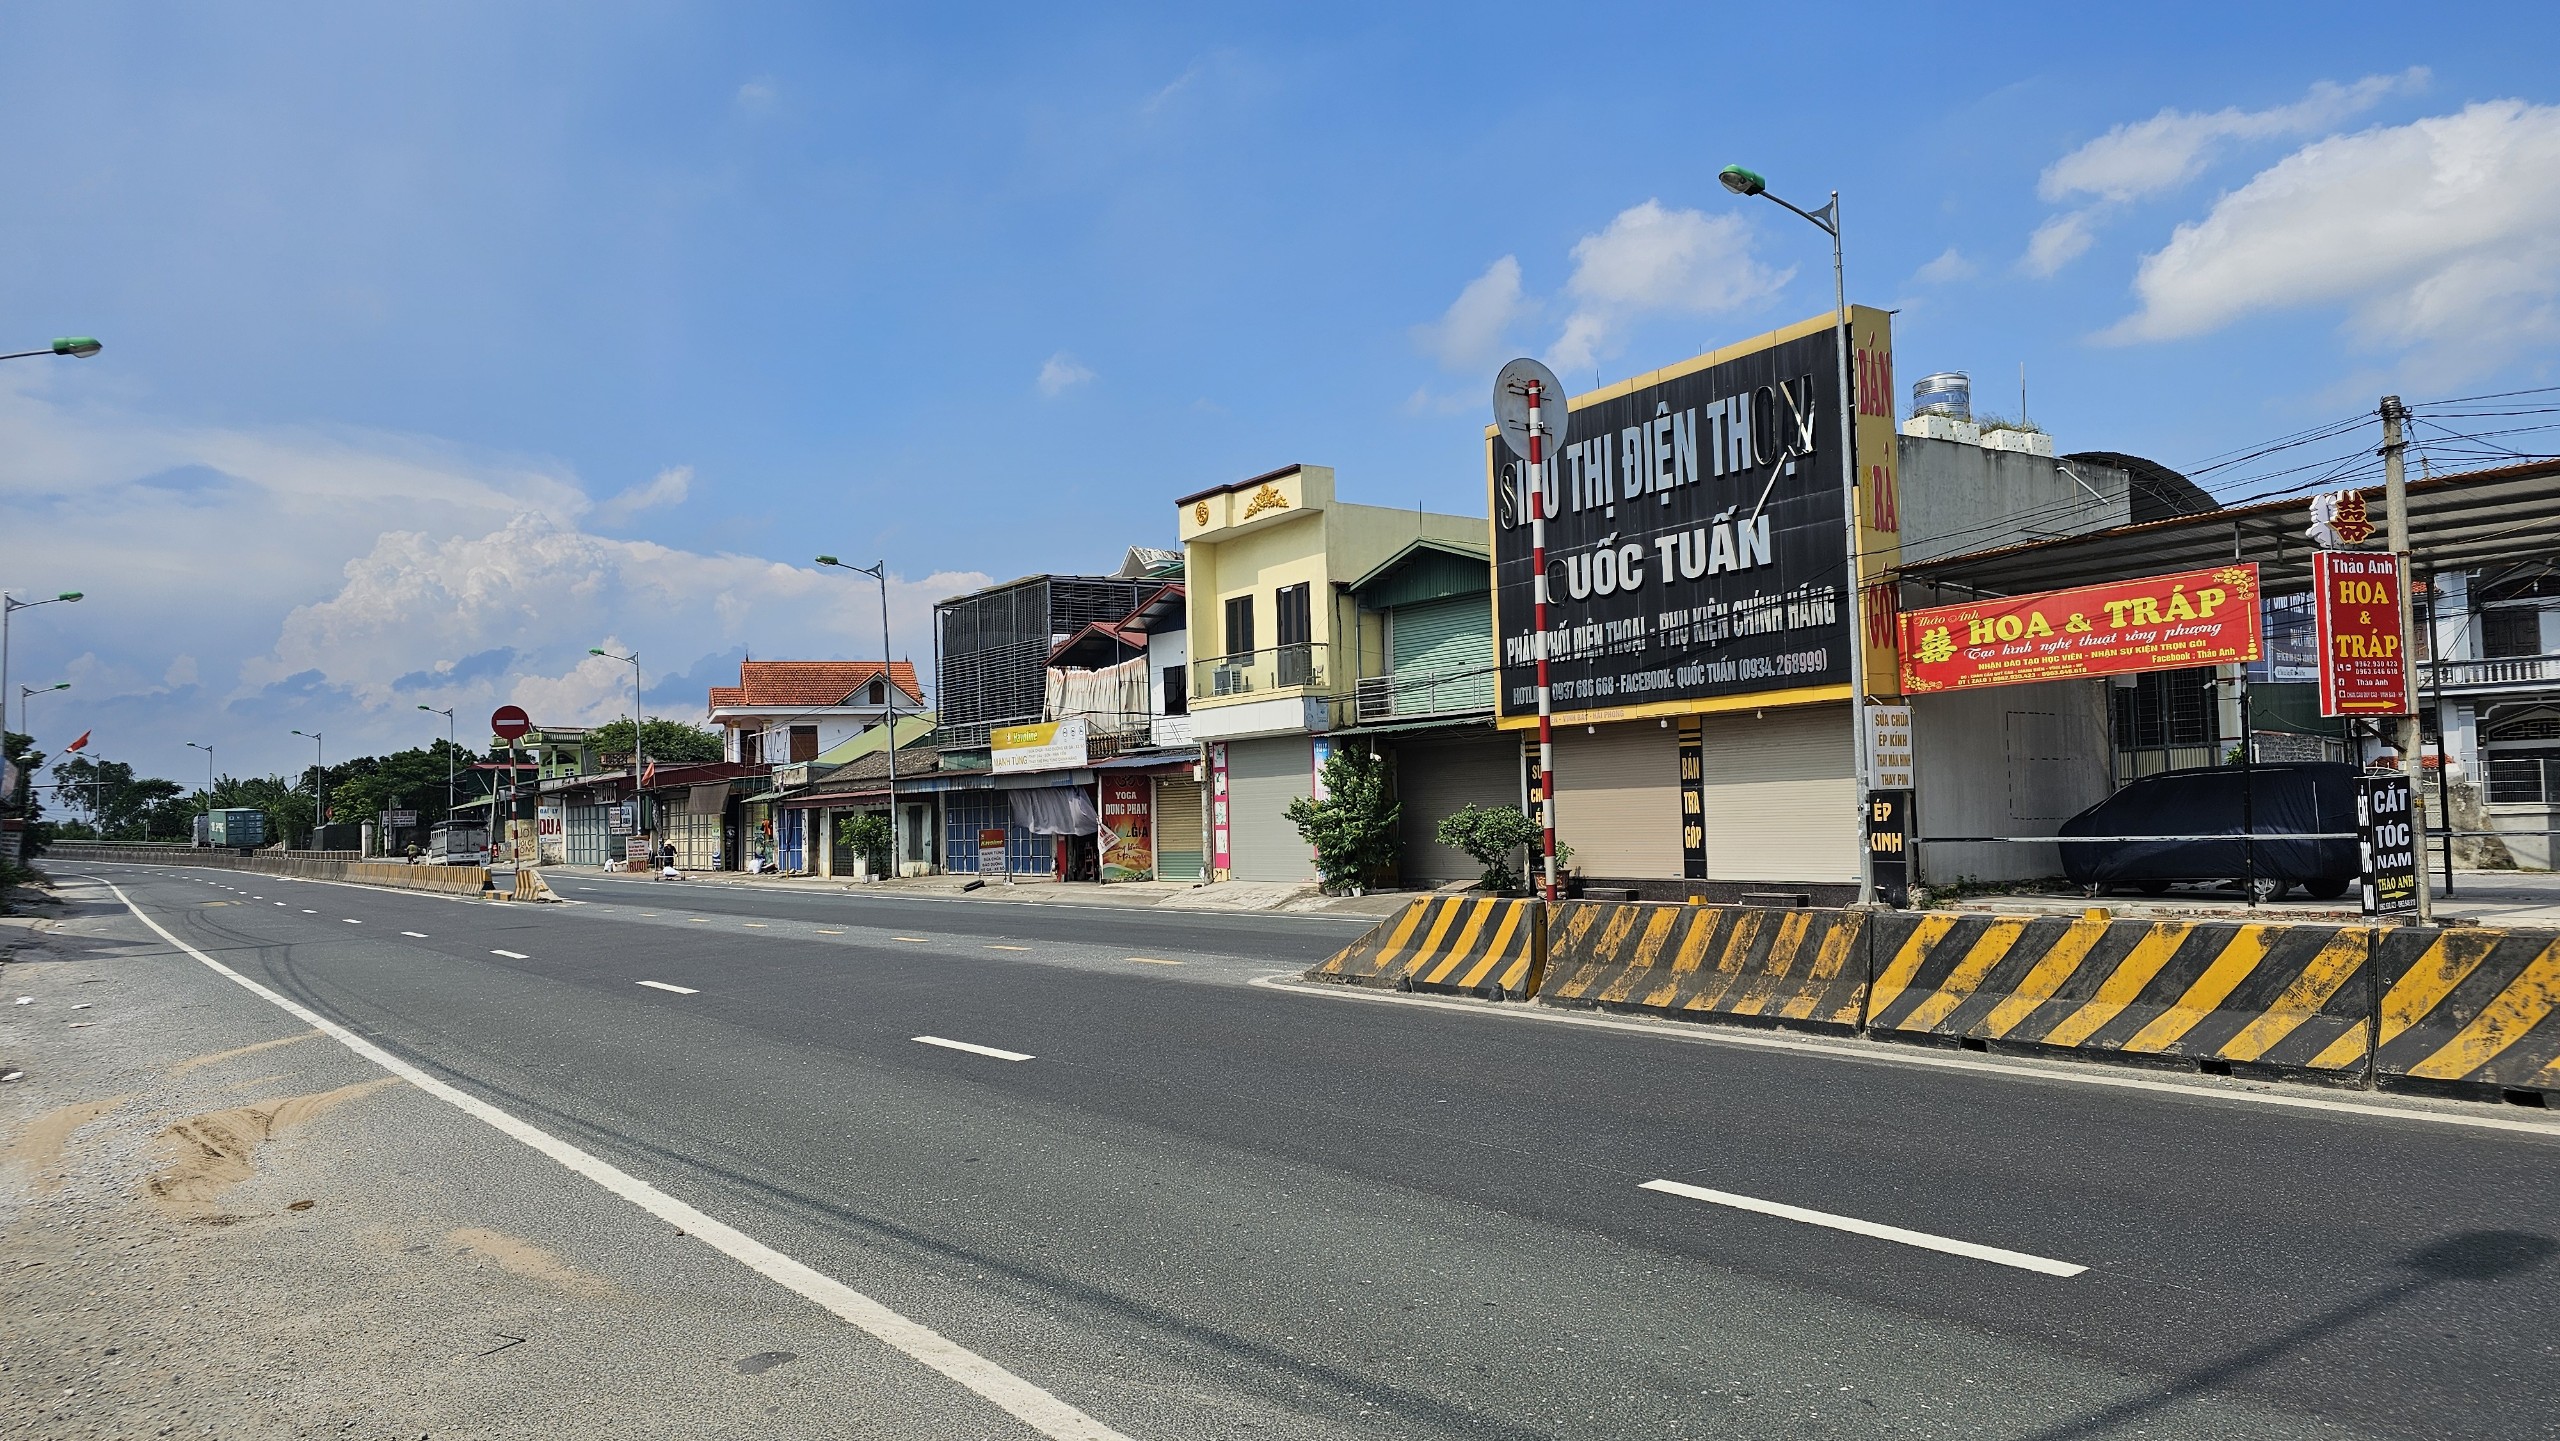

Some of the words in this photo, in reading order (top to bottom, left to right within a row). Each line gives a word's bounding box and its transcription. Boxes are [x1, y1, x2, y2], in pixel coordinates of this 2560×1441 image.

[1857, 331, 1892, 418] BÁN
[1566, 433, 1614, 519] THỊ
[1622, 401, 1698, 506] ĐIỆN
[1546, 532, 1645, 606] QUỐC
[1655, 504, 1772, 583] TUẤN
[2332, 558, 2364, 574] Thảo
[2368, 560, 2393, 575] Anh
[2338, 580, 2390, 605] HOA
[1574, 617, 1604, 664] ĐIỆN
[1606, 616, 1647, 656] THOẠI
[1659, 609, 1689, 651] PHỤ
[1693, 597, 1729, 647] KIỆN
[1733, 589, 1784, 637] CHÍNH
[1787, 583, 1836, 630] HÃNG
[1967, 611, 2054, 646] HOA
[2065, 613, 2094, 634] &
[2103, 584, 2226, 629] TRÁP
[2359, 610, 2371, 625] &
[1963, 647, 1995, 660] Tạo
[2040, 638, 2072, 656] nghệ
[2079, 631, 2117, 647] thuật
[2164, 622, 2222, 641] phượng
[2336, 628, 2398, 658] TRÁP
[1978, 661, 2001, 671] NHẬN
[2023, 657, 2040, 667] TẠO
[2042, 654, 2060, 665] HỌC
[2062, 652, 2083, 661] VIÊN
[2091, 648, 2118, 659] NHẬN
[2120, 646, 2134, 657] SỰ
[2135, 643, 2158, 655] KIỆN
[2160, 641, 2187, 652] TRỌN
[2152, 652, 2191, 663] Facebook
[2197, 649, 2217, 659] Thảo
[2219, 647, 2235, 657] Anh
[1552, 680, 1575, 701] 0937
[1576, 678, 1594, 698] 686
[1595, 676, 1614, 696] 668
[1620, 668, 1675, 694] FACEBOOK:
[1677, 659, 1705, 688] QUỐC
[1707, 655, 1736, 683] TUẤN
[2374, 678, 2389, 686] Anh
[1875, 709, 1889, 727] SỬA
[1891, 710, 1909, 727] CHỮA
[1013, 730, 1038, 743] Havoline
[1878, 731, 1887, 747] ÉP
[1890, 730, 1907, 747] KÍNH
[1681, 752, 1700, 779] BÁN
[1881, 773, 1896, 786] THAY
[1897, 773, 1908, 785] PIN
[1115, 791, 1137, 800] YOGA
[1683, 783, 1700, 814] TRẢ
[2373, 782, 2407, 814] CẮT
[1105, 803, 1125, 816] DUNG
[1873, 798, 1892, 822] ÉP
[1685, 821, 1702, 849] GÓP
[2375, 820, 2410, 849] TÓC
[2377, 852, 2412, 869] NAM
[2378, 873, 2396, 891] THẢO
[2397, 874, 2414, 888] ANH
